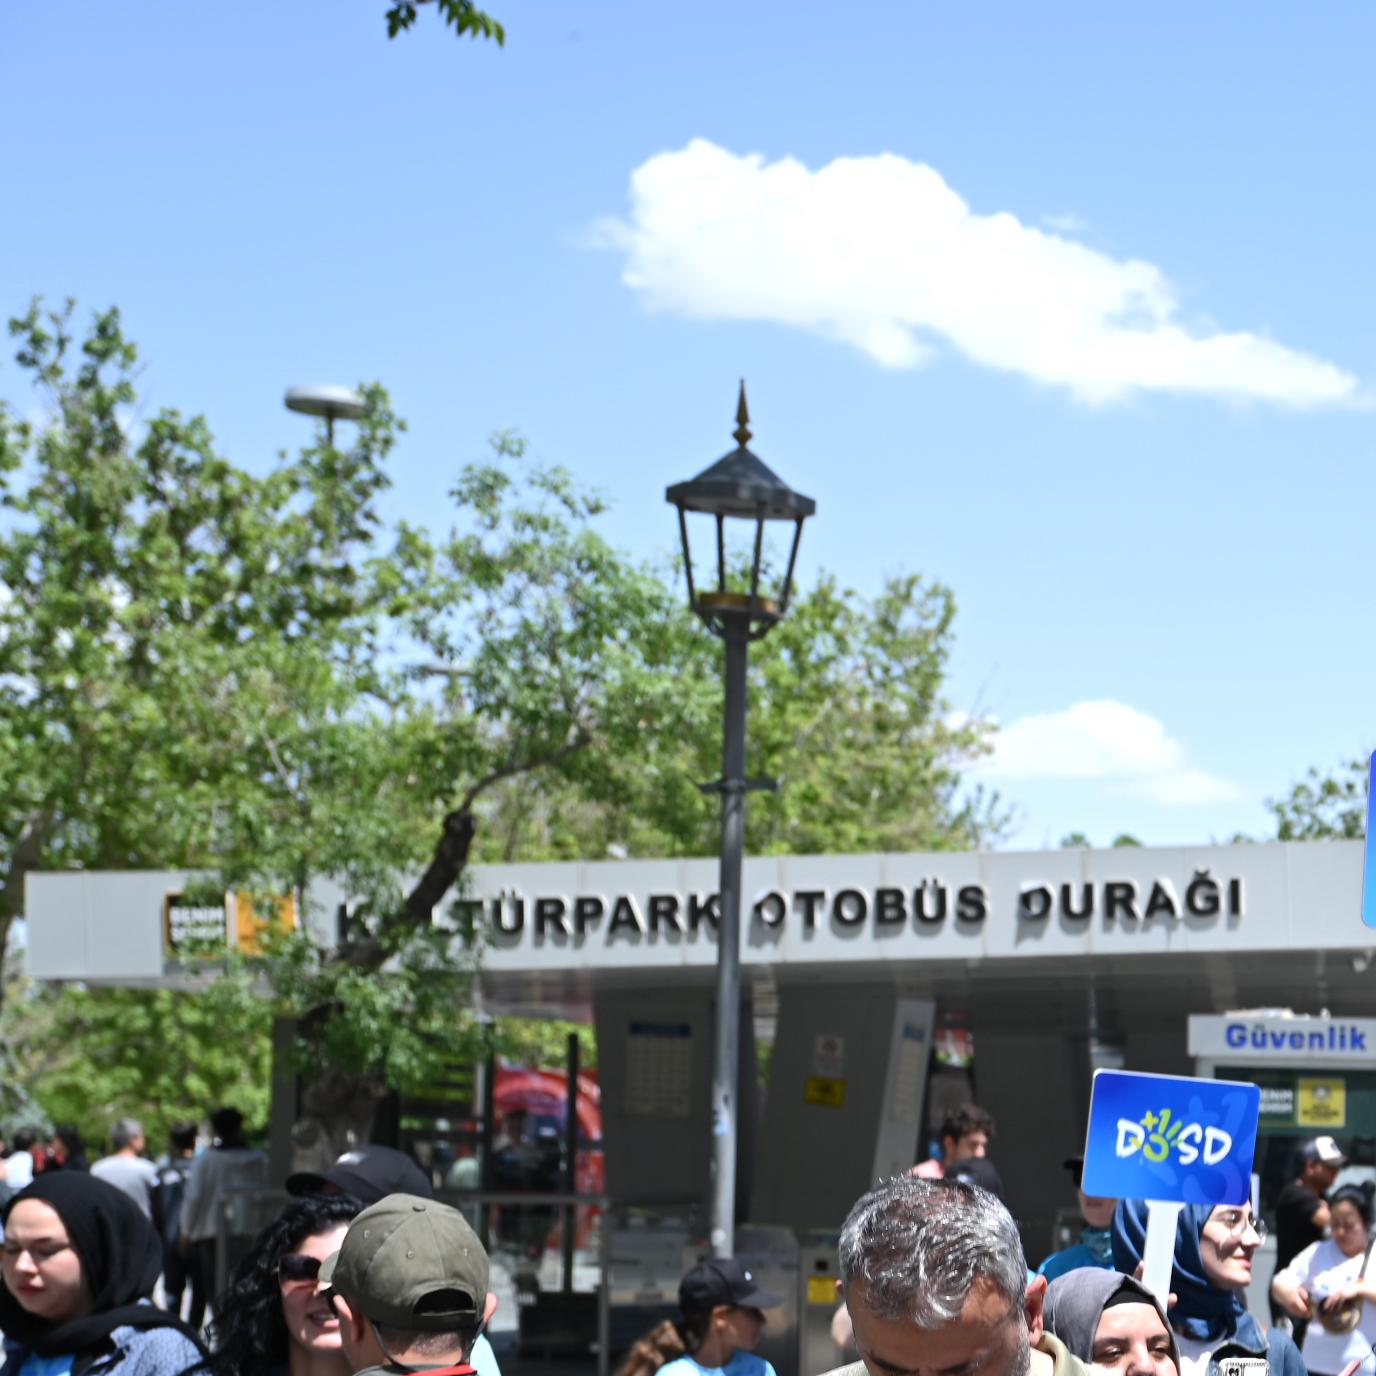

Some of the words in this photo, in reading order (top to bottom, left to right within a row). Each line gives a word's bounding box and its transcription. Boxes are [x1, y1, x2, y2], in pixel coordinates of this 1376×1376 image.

[755, 879, 986, 929] OTOBÜS
[1021, 869, 1241, 922] DURAĞI
[1225, 1023, 1367, 1051] Güvenlik
